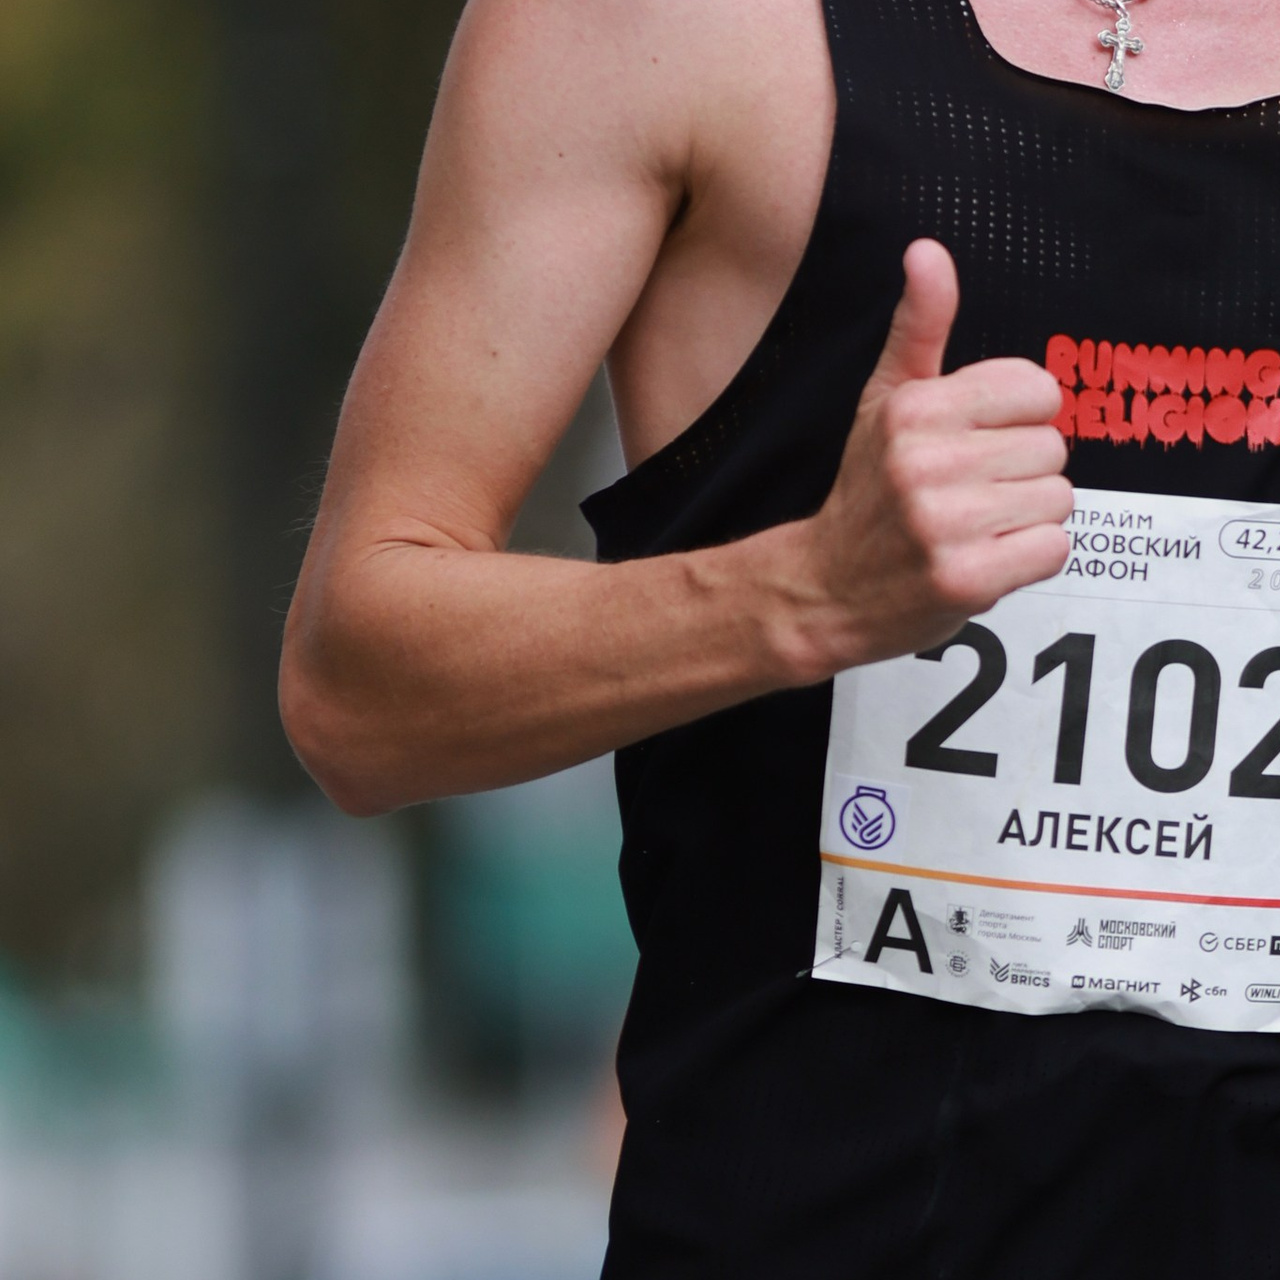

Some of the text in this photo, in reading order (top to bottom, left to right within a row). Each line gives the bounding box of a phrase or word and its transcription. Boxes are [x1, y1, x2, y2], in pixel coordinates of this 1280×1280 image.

[1071, 509, 1153, 530] ПРАЙМ
[1065, 531, 1201, 559] КОВСКИЙ
[1065, 557, 1148, 581] АФОН
[997, 809, 1213, 861] АЛЕКСЕЙ
[1099, 919, 1176, 938] МОСКОВСКИЙ
[1098, 934, 1134, 951] СПОРТ
[1223, 937, 1267, 951] СБЕР
[1010, 974, 1050, 988] BRICS
[1088, 977, 1161, 994] магнит
[1204, 986, 1227, 997] сбп
